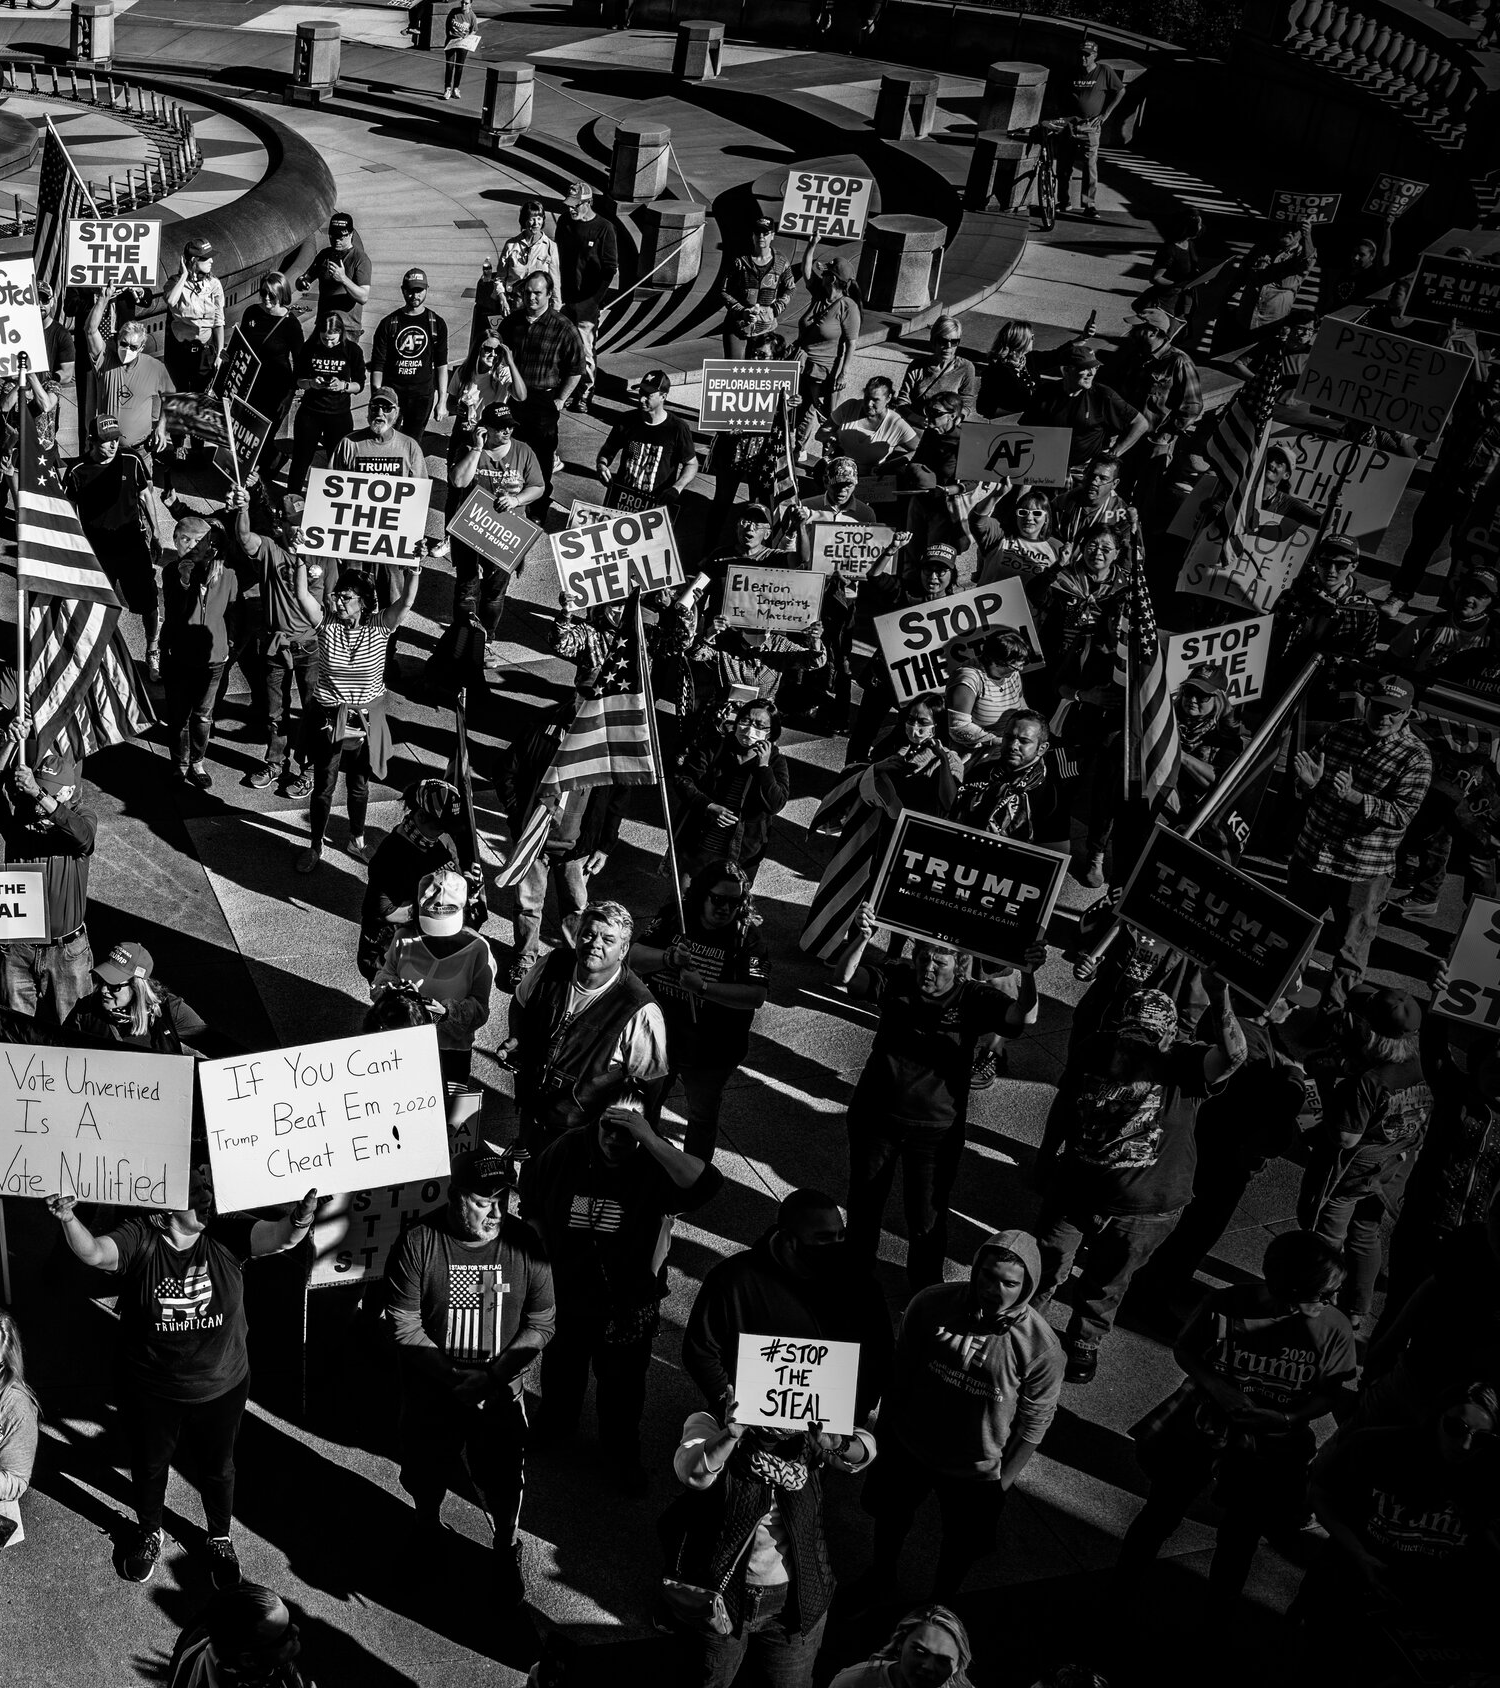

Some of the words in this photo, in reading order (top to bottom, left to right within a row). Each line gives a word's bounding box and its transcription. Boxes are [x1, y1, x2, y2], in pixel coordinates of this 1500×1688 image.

[796, 173, 863, 197] STOP
[1379, 178, 1424, 198] STOP
[803, 194, 851, 217] THE
[1279, 193, 1334, 207] STOP
[1288, 203, 1318, 214] the
[79, 222, 150, 242] STOP
[782, 212, 861, 238] STEAL
[88, 244, 140, 264] THE
[70, 265, 155, 285] STEAL
[1423, 272, 1500, 297] TRUM
[311, 356, 346, 368] TRUMP
[1336, 327, 1446, 376] PISSED
[398, 368, 418, 376] FIRST
[708, 378, 772, 390] DEPLORABLES
[1362, 365, 1420, 394] OFF
[708, 391, 782, 412] TRUM
[1301, 369, 1445, 434] PATRIOTS
[358, 462, 400, 472] TRUMP
[984, 439, 1034, 472] AF
[1296, 431, 1390, 483] STOP
[323, 475, 416, 502] STOP
[330, 502, 402, 530] THE
[468, 502, 522, 550] Women
[304, 526, 416, 560] STEAL
[468, 520, 486, 536] FOR
[484, 532, 510, 552] TRUMP
[559, 510, 664, 561] STOP
[834, 532, 874, 544] STOP
[591, 548, 630, 566] THE
[569, 549, 673, 608] STEAL!
[732, 606, 745, 618] It
[757, 594, 810, 610] Integrity
[899, 593, 1002, 650] STOP
[1181, 624, 1260, 661] STOP
[890, 648, 951, 697] THE
[902, 849, 1041, 902] TRUMP
[906, 873, 1020, 916] PENCE
[1155, 861, 1289, 950] TRUMP
[923, 895, 960, 910] AMERICA
[961, 906, 988, 918] GREAT
[989, 914, 1020, 928] AGAIN!
[1158, 884, 1268, 958] PENCE
[5, 1050, 56, 1094] Vote
[65, 1055, 160, 1101] Unverified
[225, 1061, 264, 1102] If
[14, 1098, 50, 1135] Is
[76, 1102, 102, 1140] A
[274, 1101, 328, 1136] Beat
[344, 1091, 381, 1122] Em
[393, 1094, 436, 1115] 2020
[211, 1127, 260, 1153] Trump
[267, 1146, 334, 1179] Cheat
[354, 1124, 402, 1162] Em!
[60, 1151, 167, 1205] Nullified
[154, 1314, 224, 1334] TRUMPLICAN
[760, 1338, 828, 1366] #STOP
[1218, 1341, 1317, 1391] Trump
[1280, 1346, 1317, 1366] 2020
[774, 1366, 813, 1387] THE
[759, 1388, 830, 1423] STEAL
